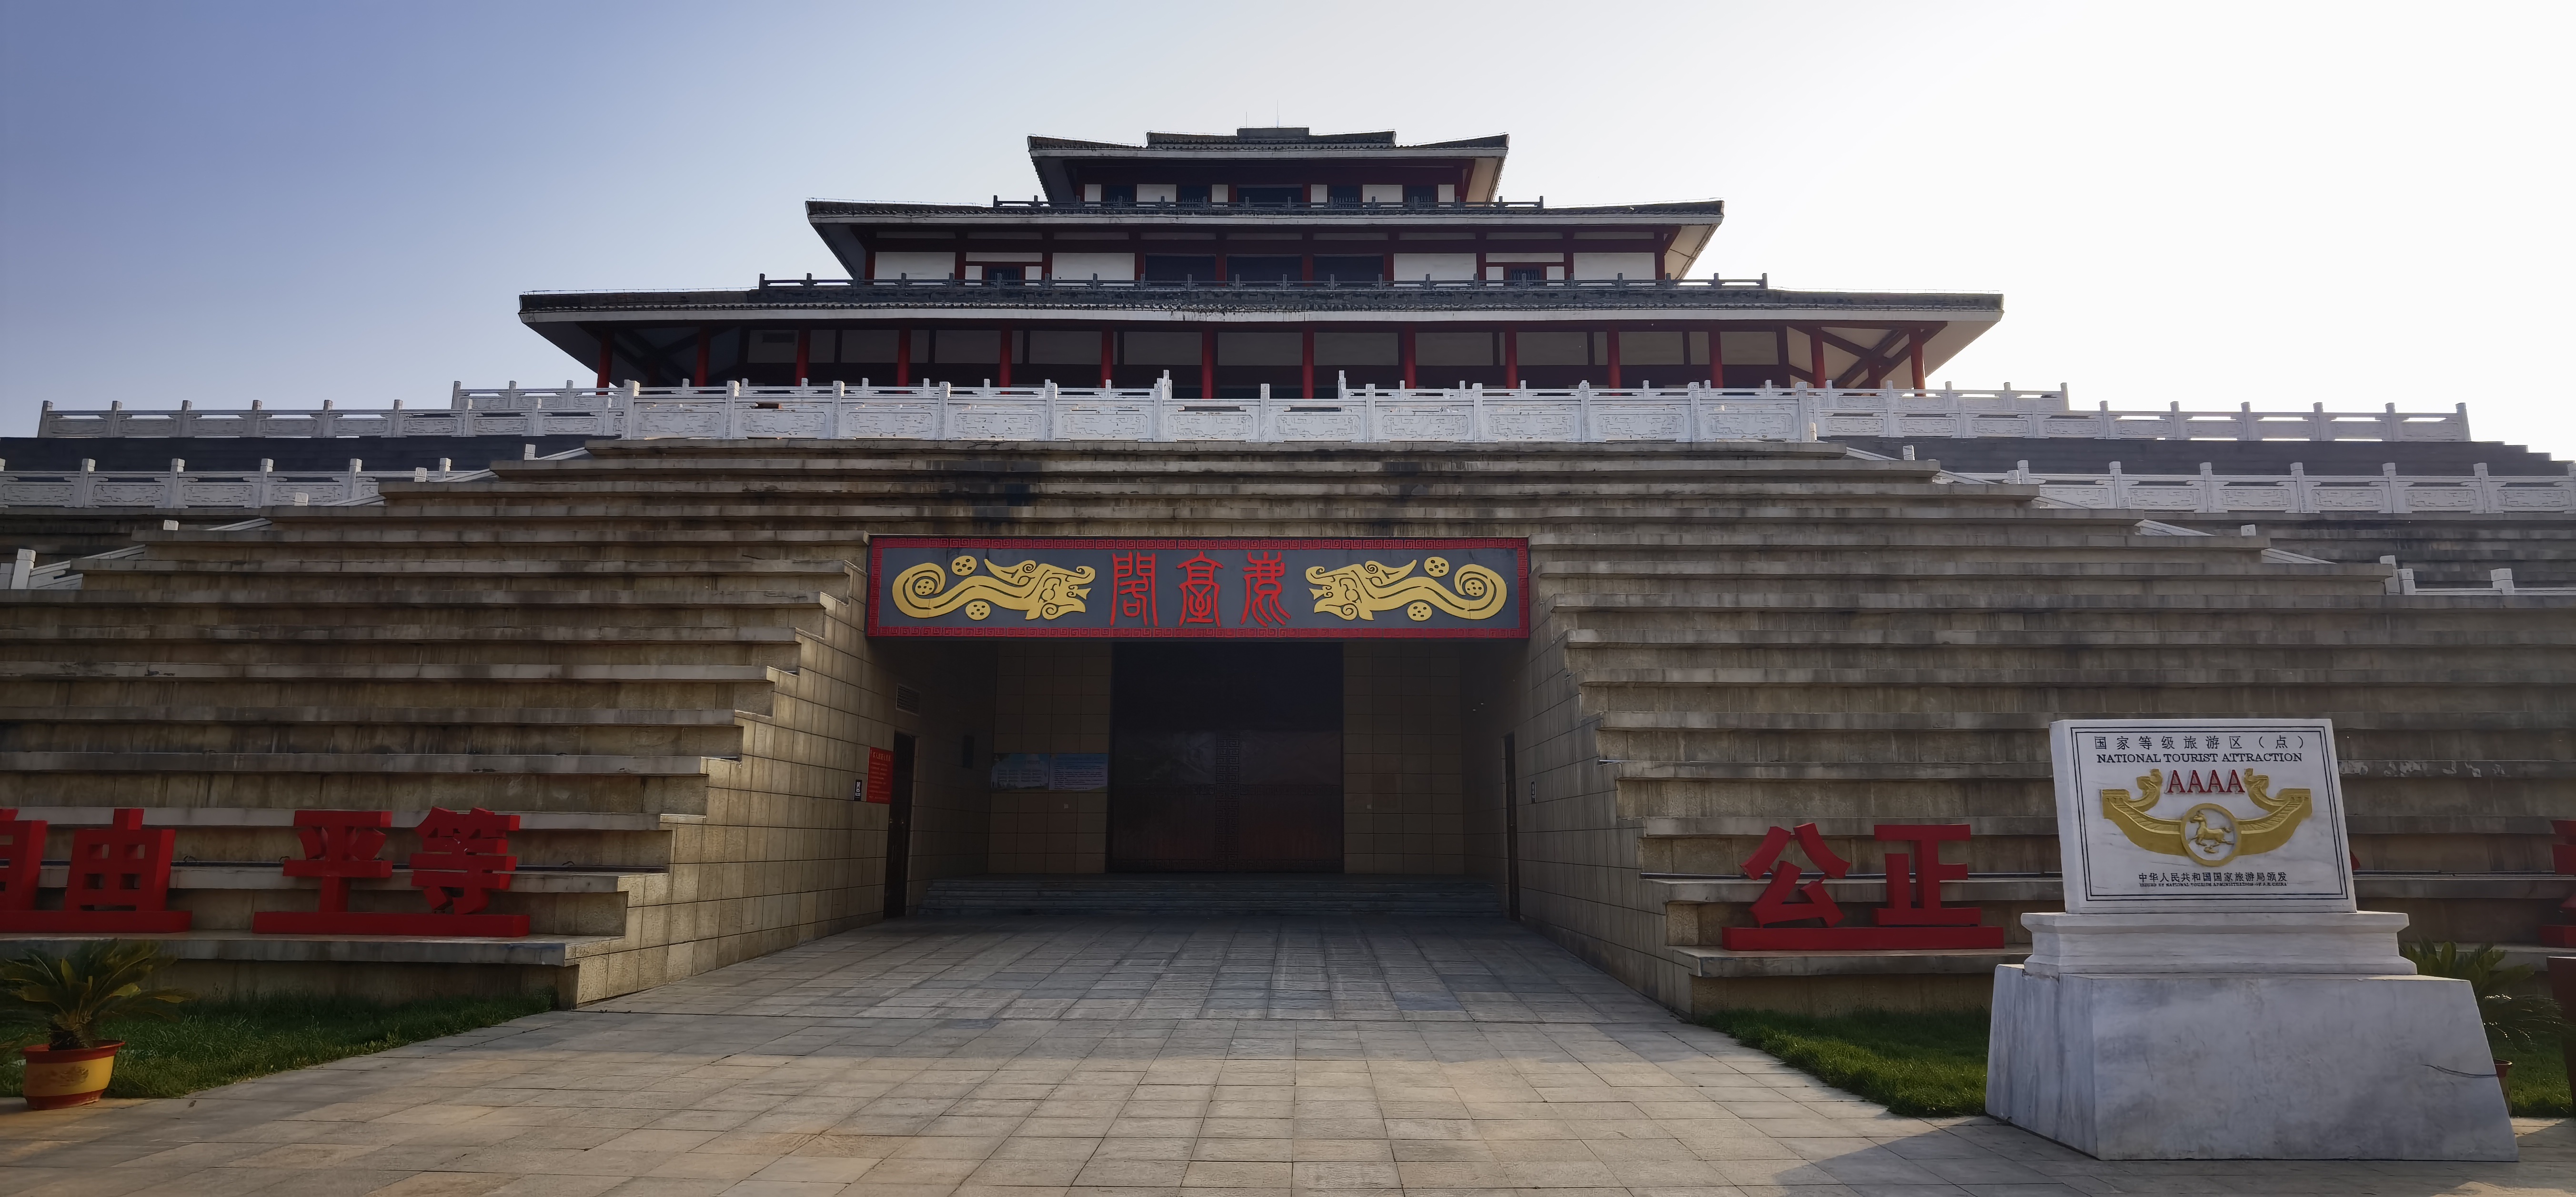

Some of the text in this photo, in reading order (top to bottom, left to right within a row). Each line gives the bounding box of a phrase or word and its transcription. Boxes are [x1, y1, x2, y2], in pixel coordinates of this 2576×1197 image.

[2096, 753, 2302, 763] NATIONAL TOURIST ATTRACTION
[2166, 769, 2245, 794] AAAA
[282, 807, 521, 915] 平等
[1740, 823, 1981, 928] 公正
[2139, 872, 2287, 883] 中华人民共和国国家旅游局颁发
